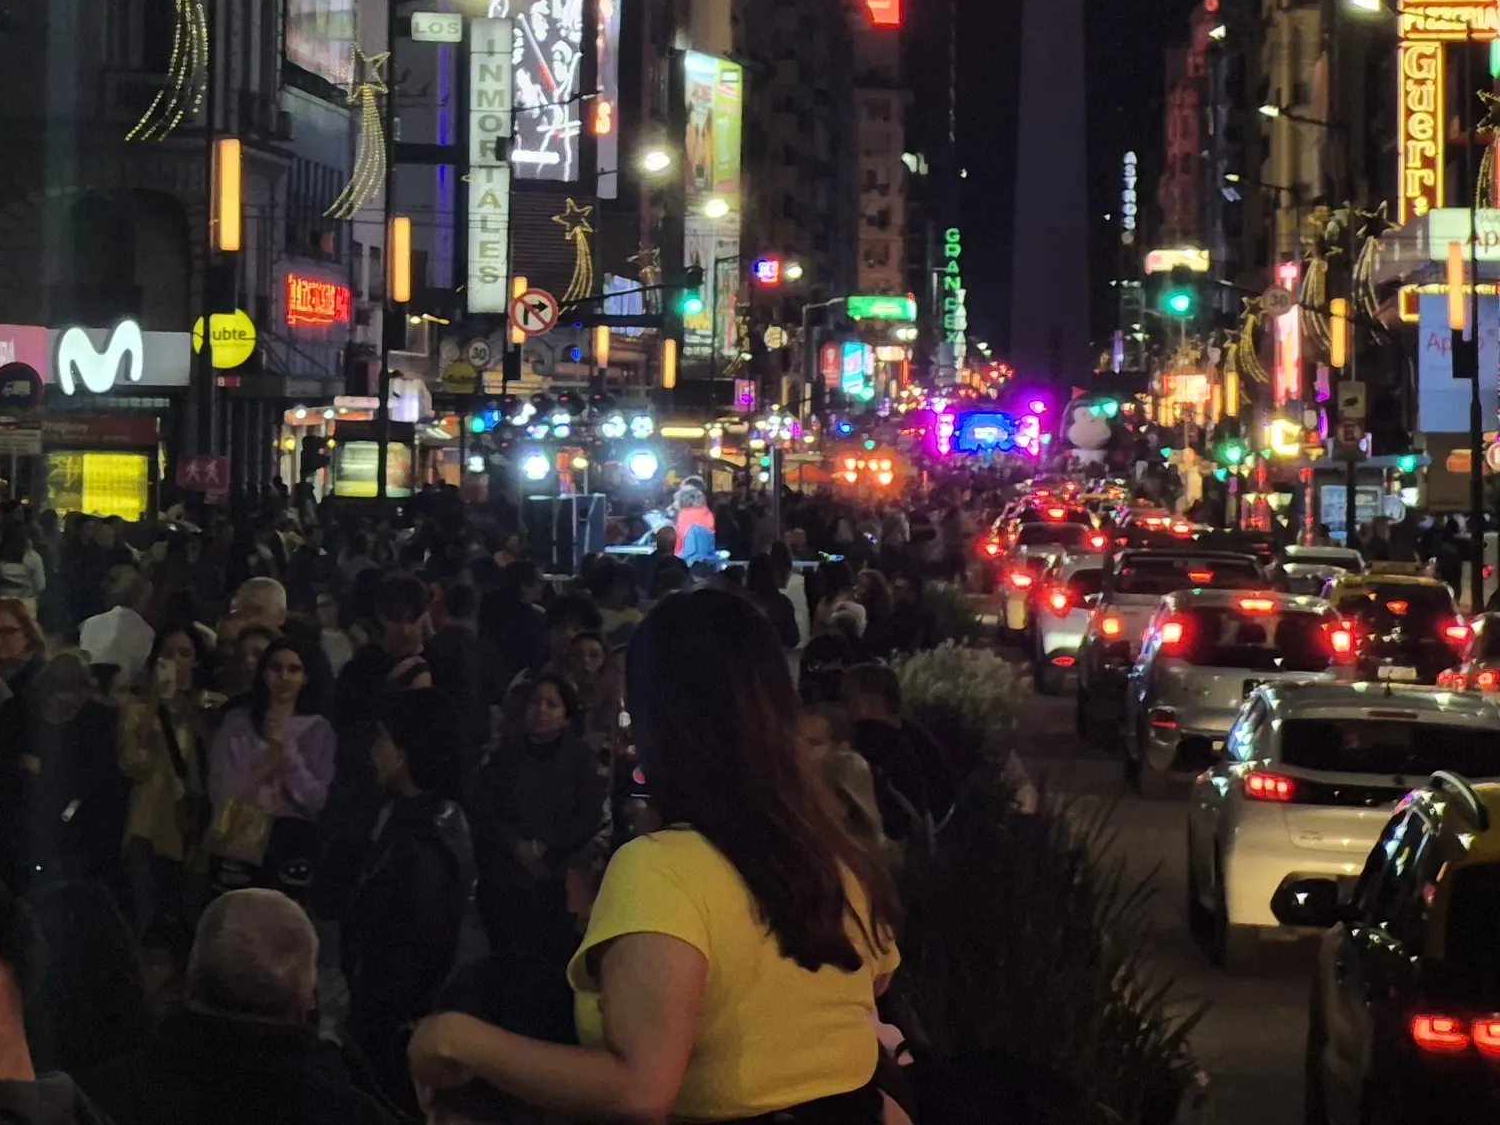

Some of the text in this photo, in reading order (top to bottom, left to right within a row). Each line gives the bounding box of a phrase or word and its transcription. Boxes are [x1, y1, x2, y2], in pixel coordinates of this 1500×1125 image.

[414, 21, 459, 34] LOS
[477, 39, 504, 284] INMORTALES
[944, 228, 961, 290] GRAN
[212, 327, 247, 341] ubte
[472, 347, 487, 361] 30
